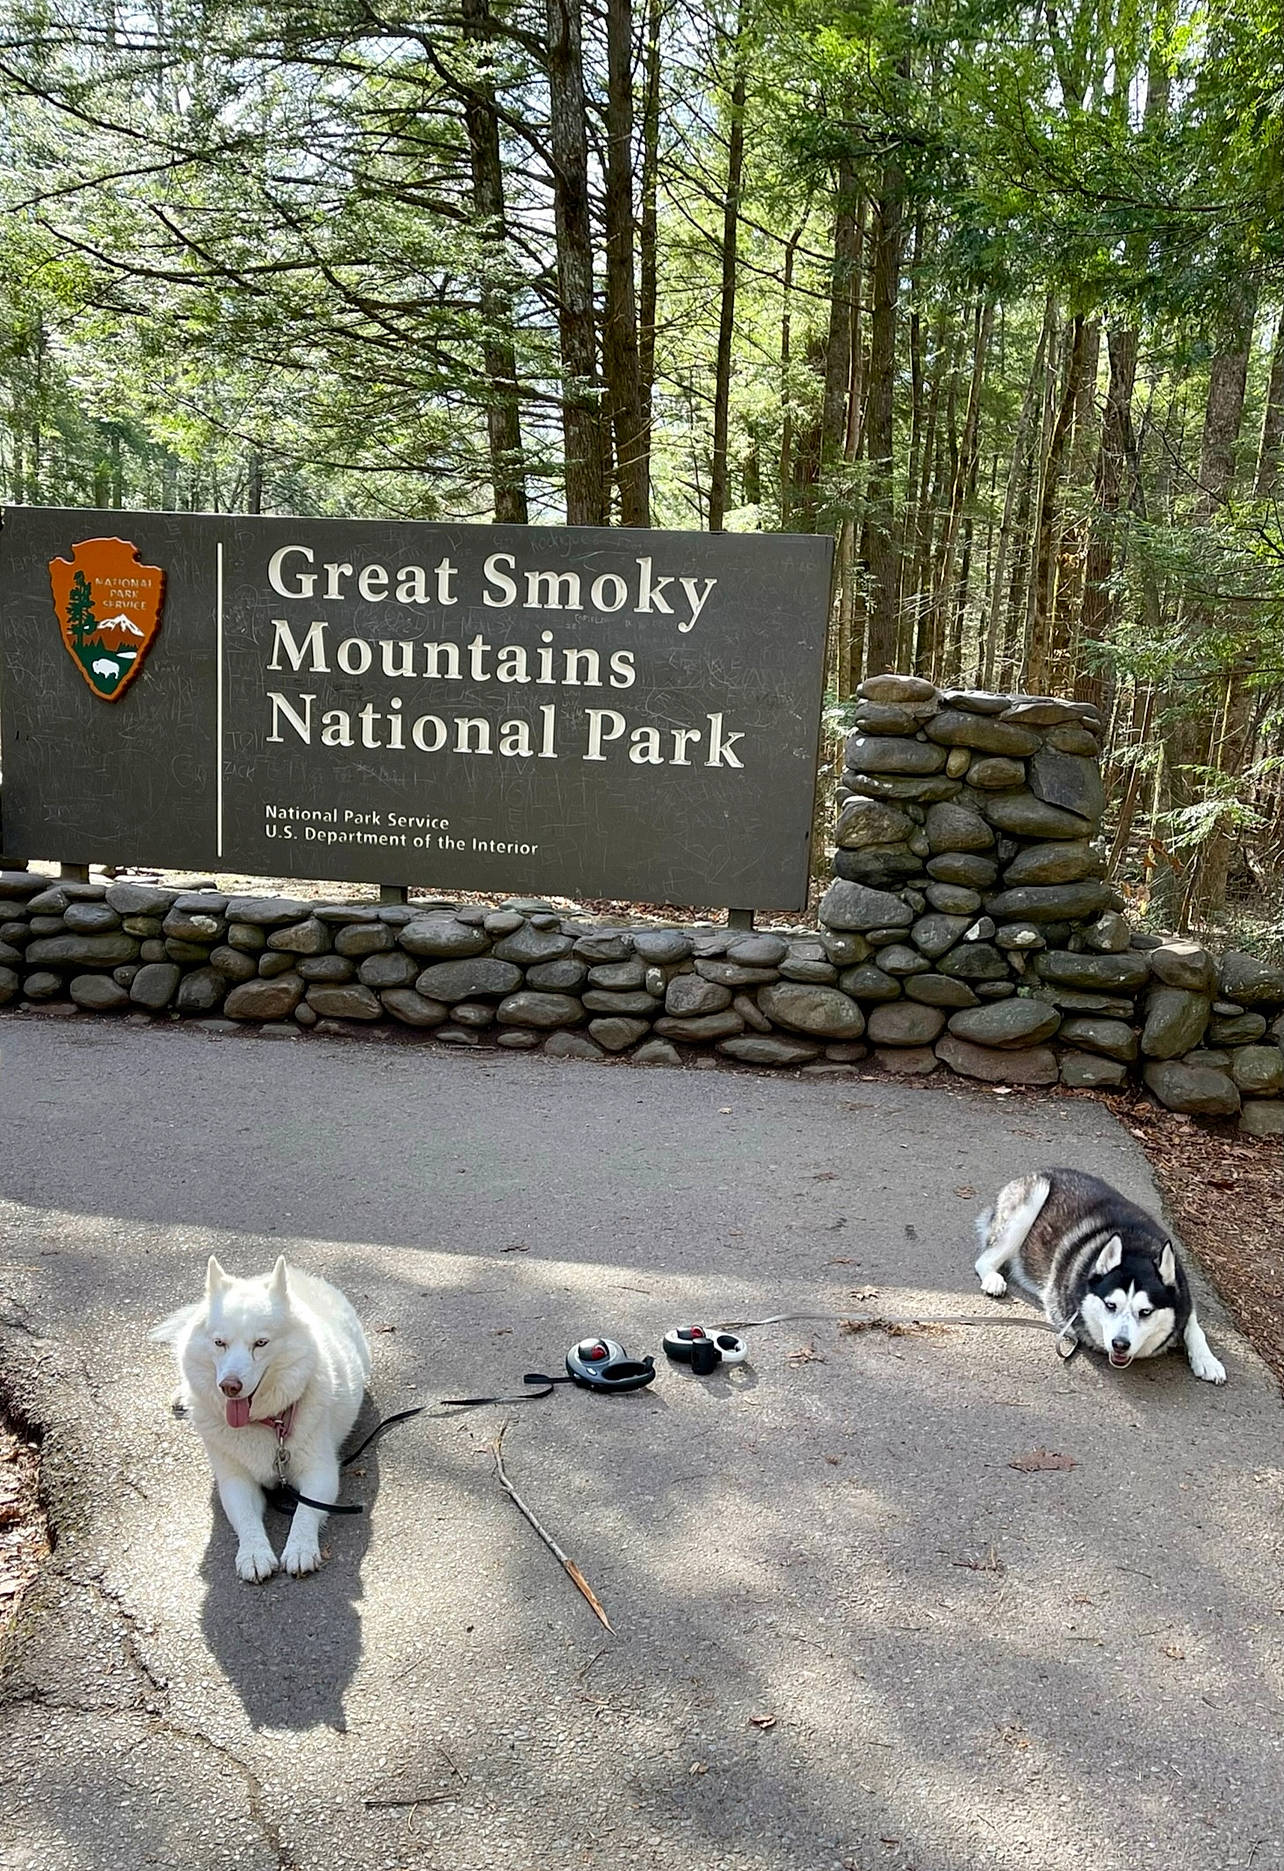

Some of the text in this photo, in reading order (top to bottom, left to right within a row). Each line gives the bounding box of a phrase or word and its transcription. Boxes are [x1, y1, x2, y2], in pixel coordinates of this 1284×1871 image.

[95, 577, 152, 588] NATIONAL
[110, 589, 139, 599] PARK
[268, 545, 459, 606] Great
[482, 552, 718, 634] Smoky
[102, 599, 147, 610] SERVICE
[266, 619, 636, 689] Mountains
[266, 692, 558, 759] National
[582, 708, 746, 769] Park
[265, 805, 450, 830] National Park Service
[265, 824, 539, 856] U.S. Department of the Interior
